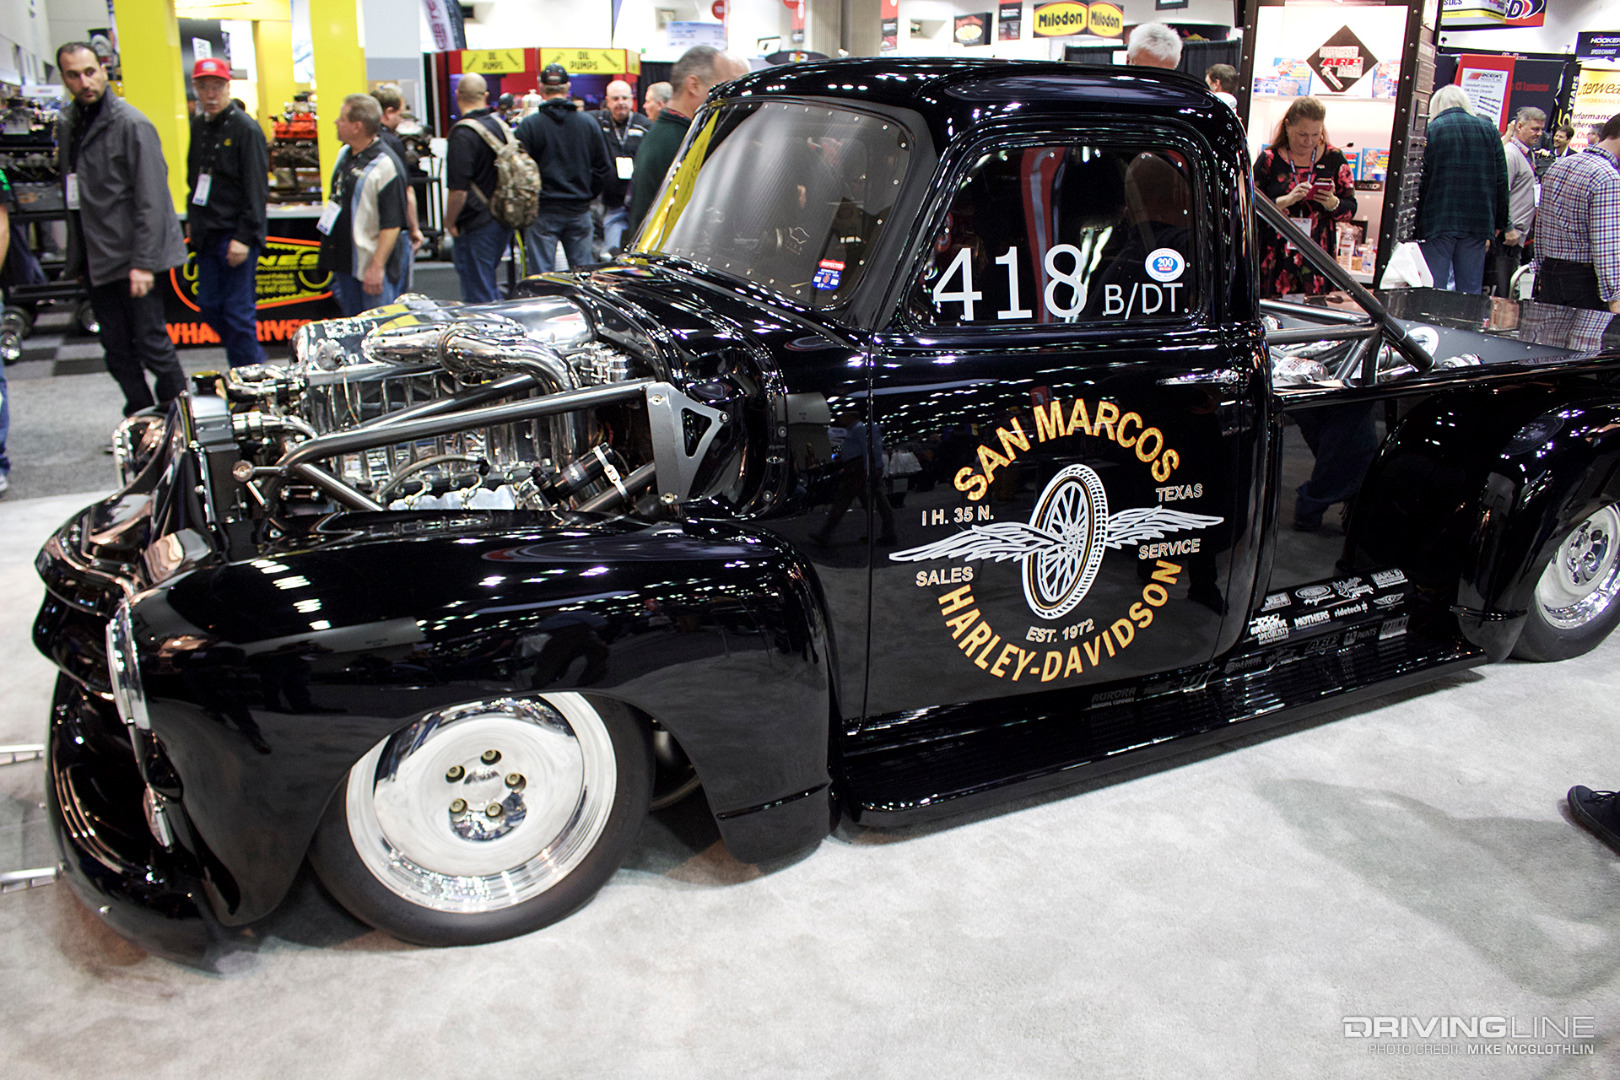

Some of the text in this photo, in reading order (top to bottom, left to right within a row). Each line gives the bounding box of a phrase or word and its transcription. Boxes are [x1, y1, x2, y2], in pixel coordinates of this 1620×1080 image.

[1038, 12, 1083, 28] Milodon
[1091, 11, 1120, 28] Milodon
[577, 51, 589, 59] OIL
[1322, 58, 1361, 66] ARP
[570, 60, 598, 70] PUMPS
[1567, 75, 1579, 111] YEARS
[1157, 257, 1174, 267] 200
[933, 244, 1183, 321] 418 B/DT
[953, 398, 1180, 501] SAN MARCOS
[1156, 484, 1203, 502] TEXAS
[953, 507, 973, 523] 35
[977, 505, 994, 521] N.
[1138, 539, 1201, 560] SERVICE
[916, 566, 974, 587] SALES
[1293, 610, 1330, 627] MOTHERS
[1334, 603, 1362, 617] ridetech
[938, 560, 1183, 683] HARLEY-DAVIDSON
[1026, 619, 1095, 644] EST. 1972
[1092, 687, 1137, 701] AURORA
